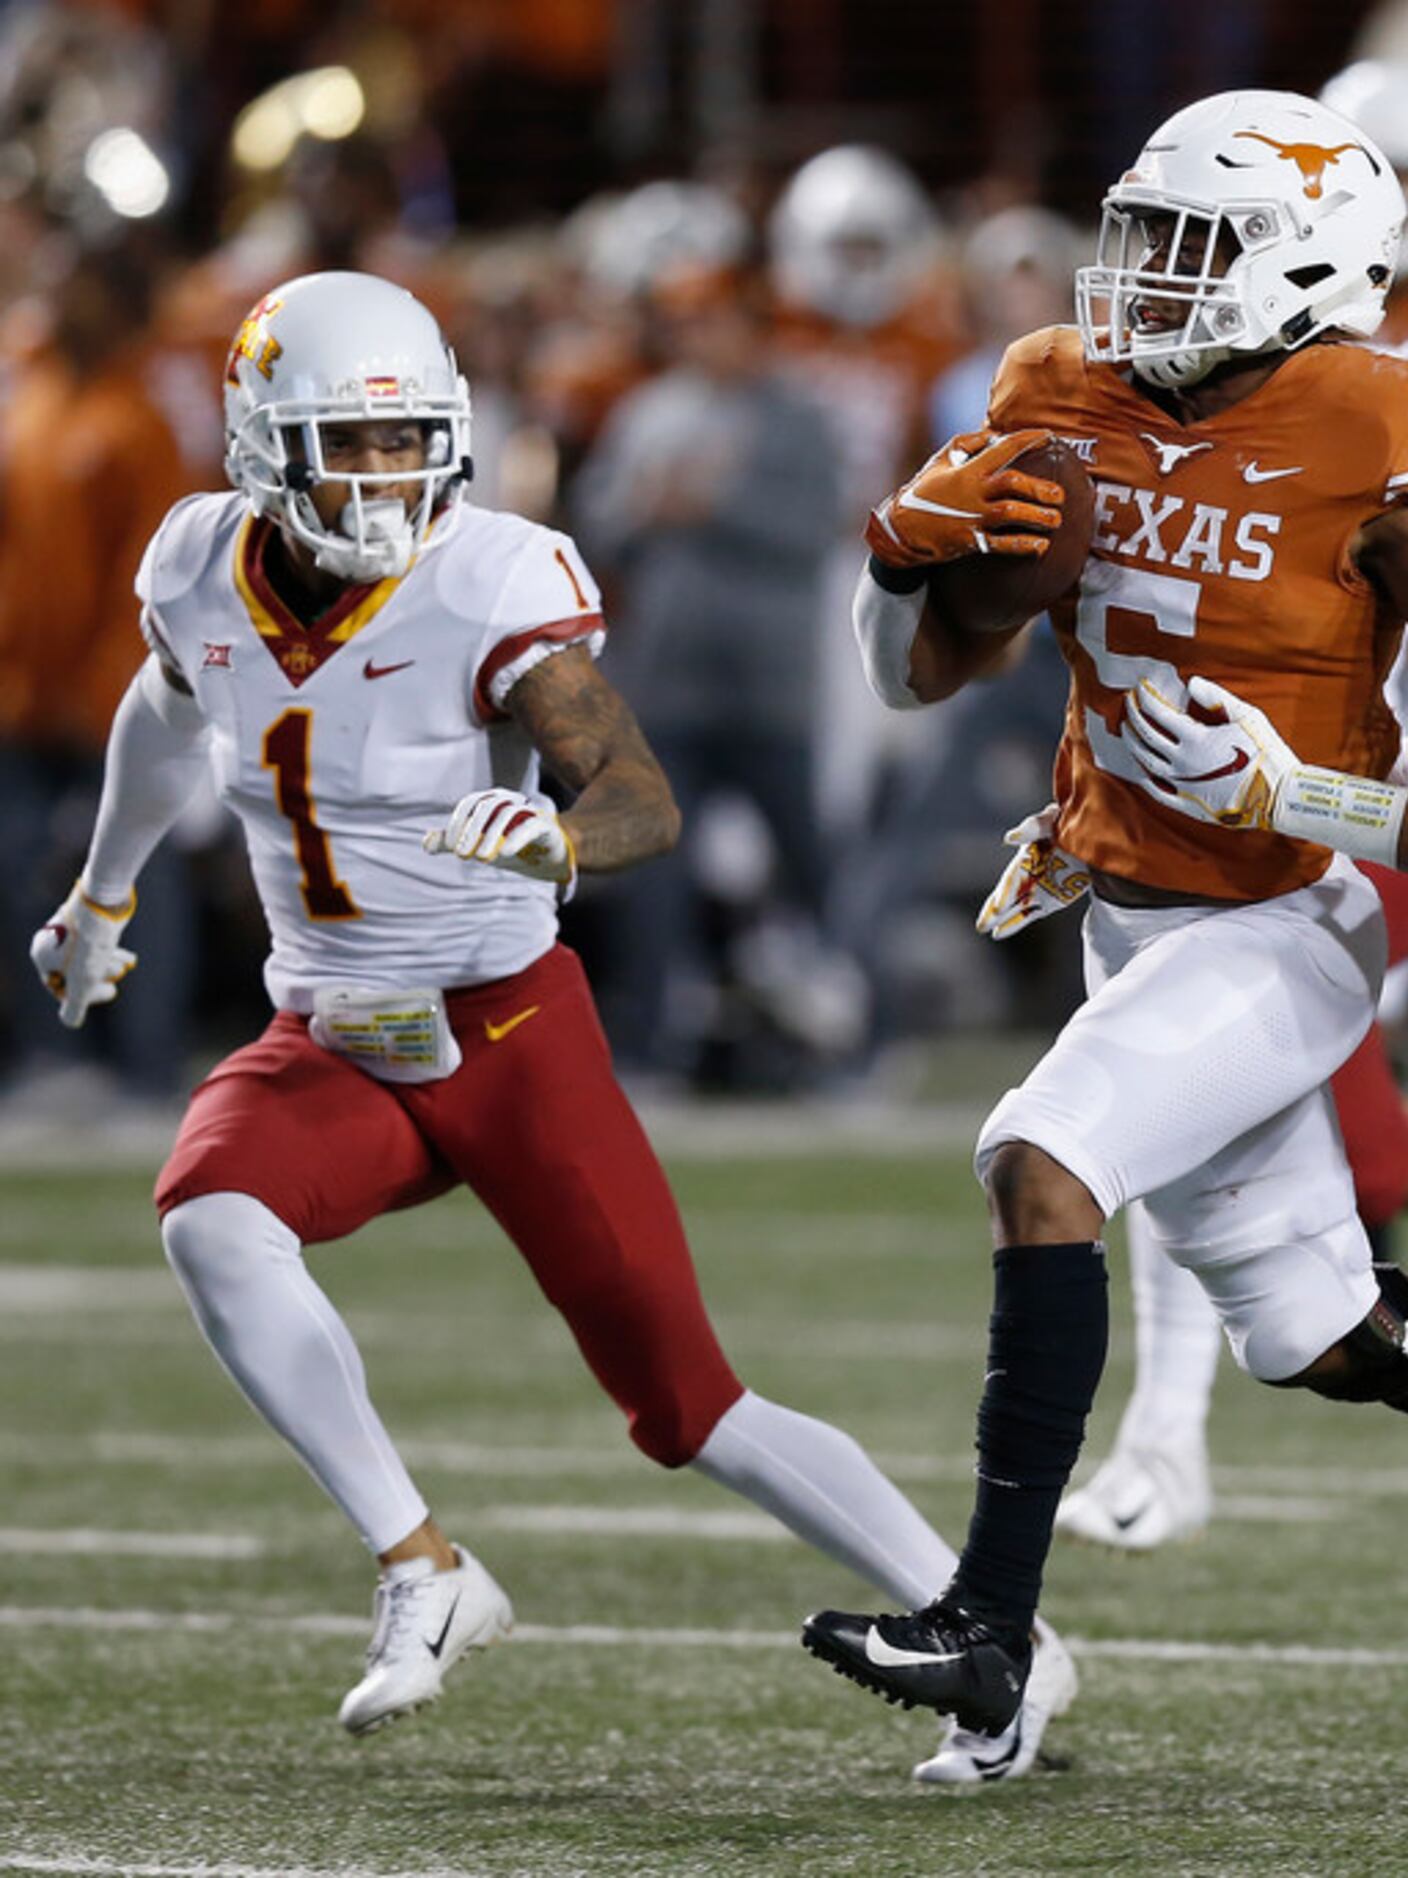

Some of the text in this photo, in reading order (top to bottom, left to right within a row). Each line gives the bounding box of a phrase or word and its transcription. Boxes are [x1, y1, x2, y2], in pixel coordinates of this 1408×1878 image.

[555, 549, 588, 609] 1
[1094, 480, 1282, 582] EXAS
[1075, 556, 1203, 789] 5
[261, 707, 364, 921] 1
